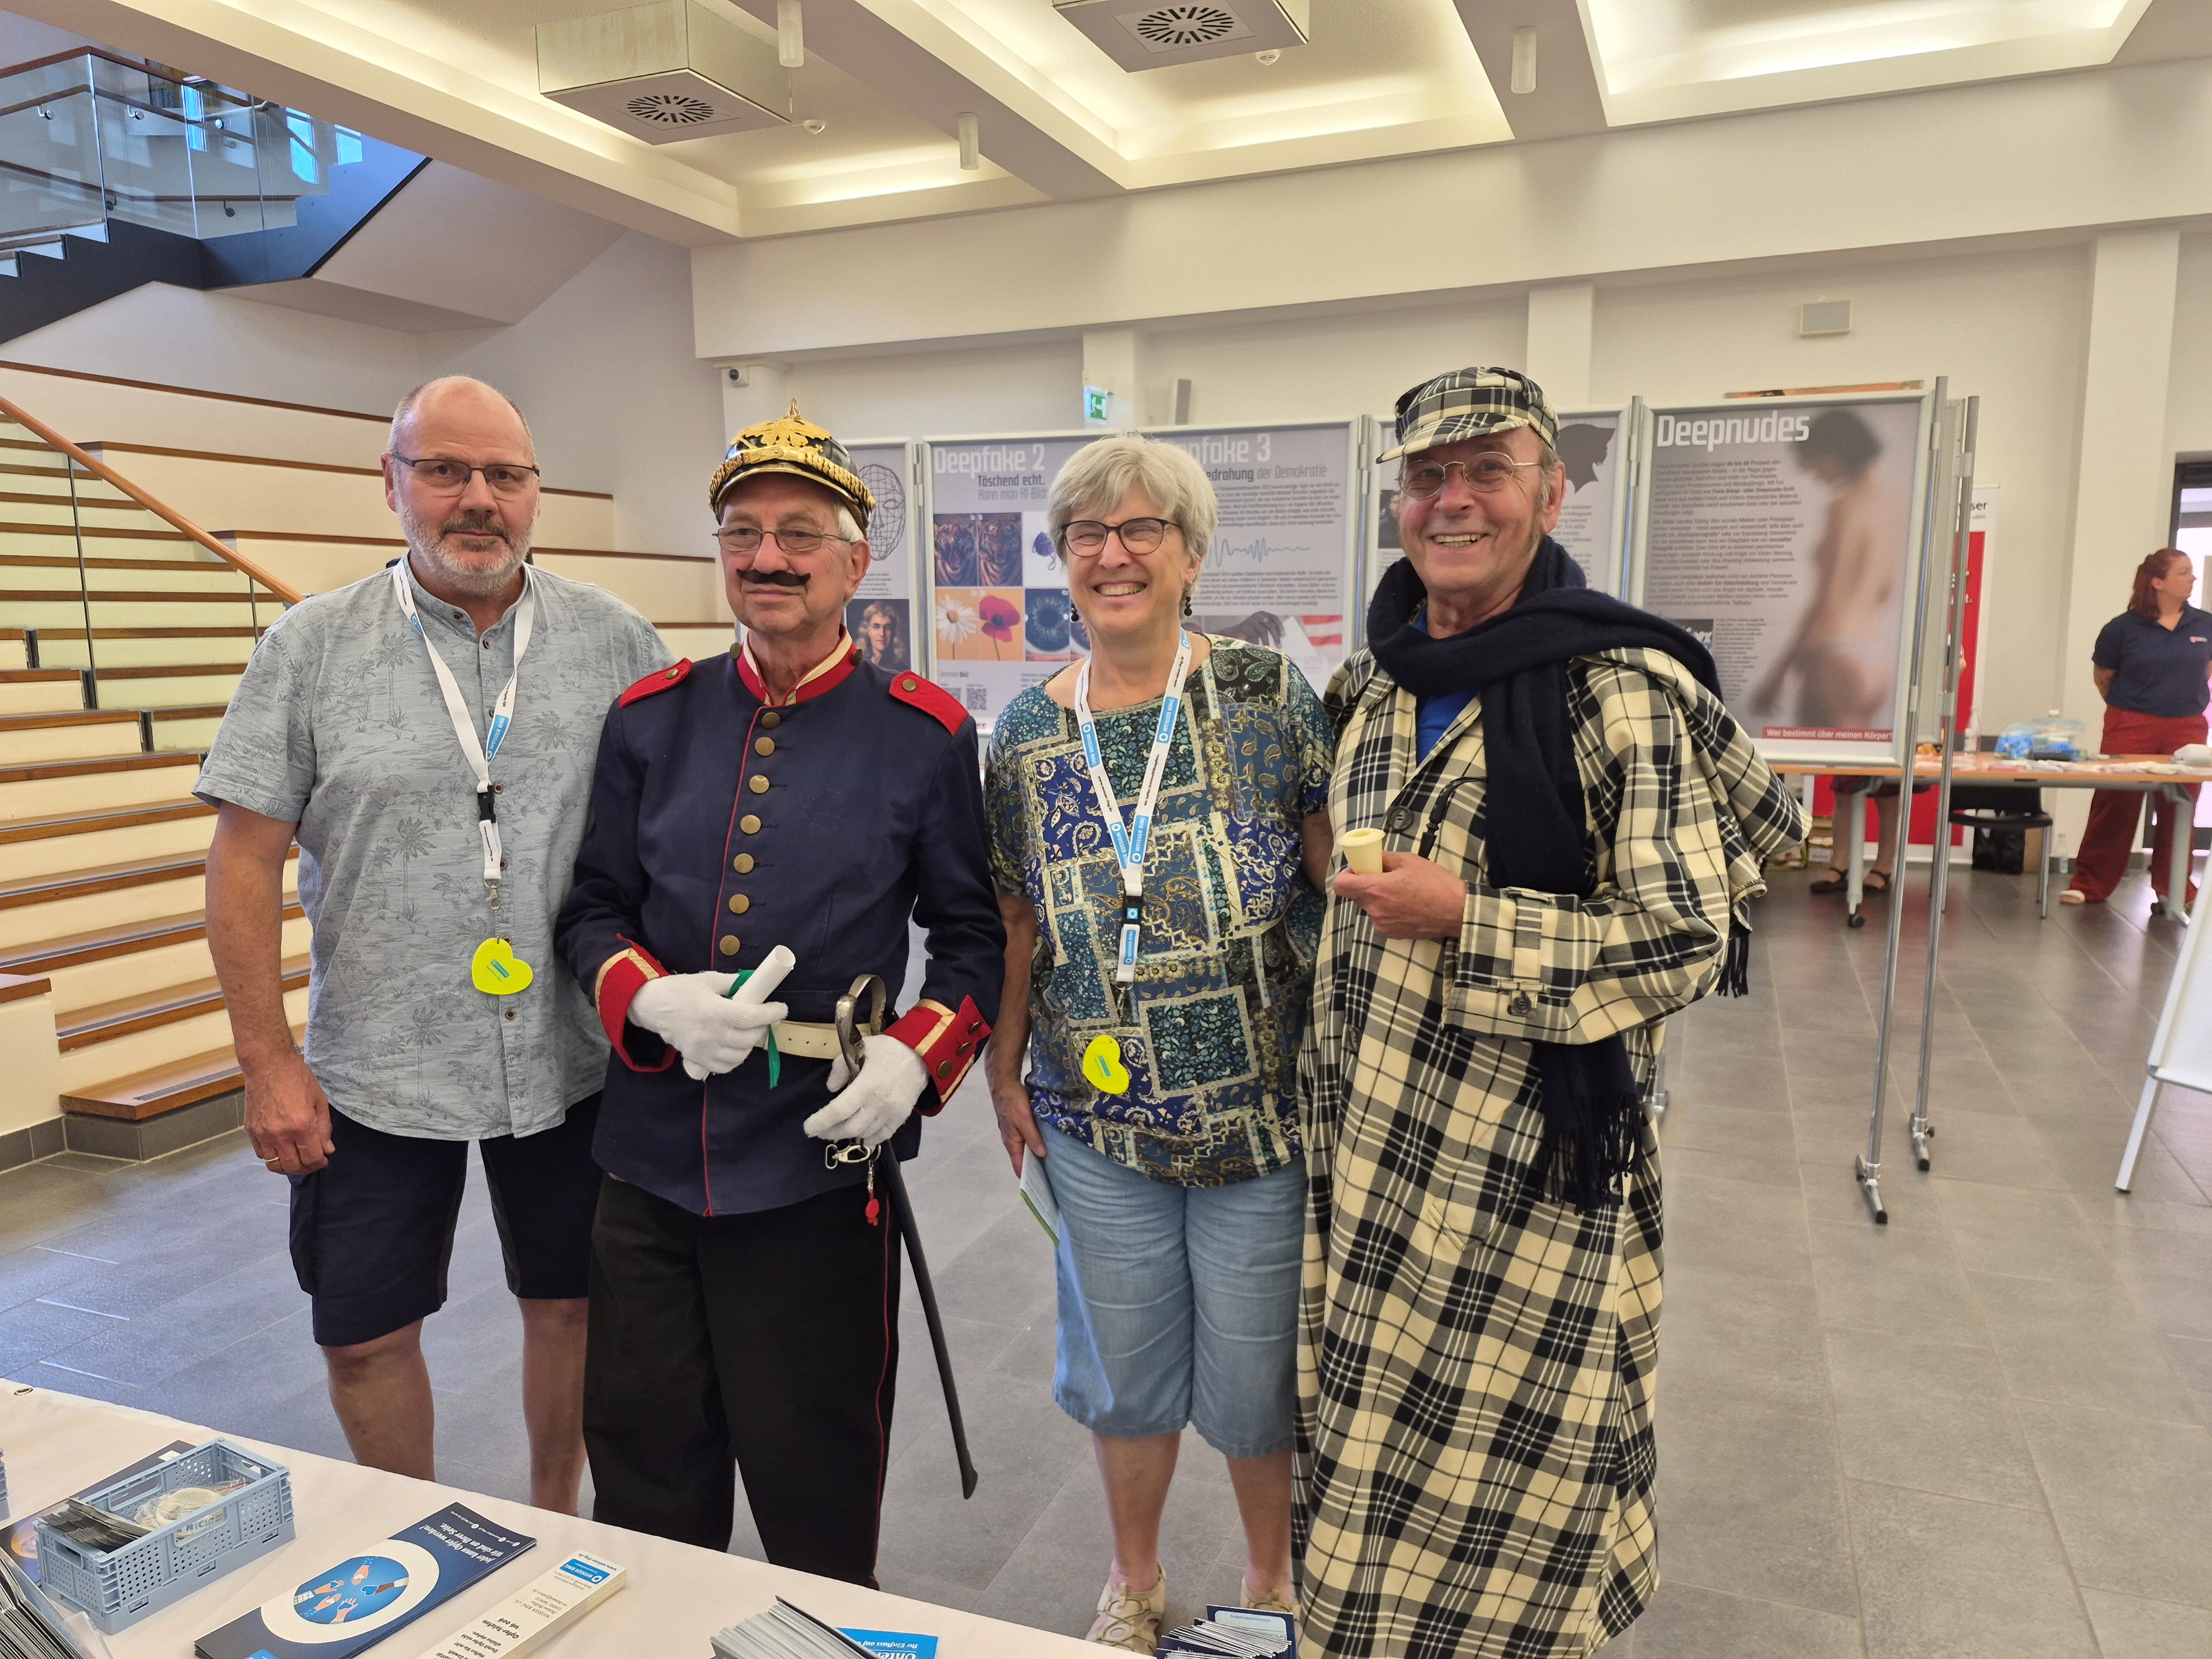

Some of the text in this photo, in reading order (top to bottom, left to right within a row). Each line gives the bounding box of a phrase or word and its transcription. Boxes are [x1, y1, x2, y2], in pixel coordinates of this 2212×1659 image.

[1657, 410, 1809, 452] Deepnudes
[1184, 433, 1270, 465] pfake 3
[933, 444, 1045, 479] Deepfake 2
[1022, 474, 1045, 486] echt.
[1206, 465, 1327, 482] edrohung der Demokratie
[978, 489, 998, 500] Kann
[1000, 491, 1018, 500] man
[1162, 713, 1171, 732] WEISSER
[490, 729, 502, 750] WEISSER
[1767, 728, 1781, 737] Wer
[1783, 729, 1816, 738] bestimmt
[1818, 729, 1834, 738] über
[1835, 731, 1863, 739] meinen
[1086, 733, 1094, 753] WEISSER
[1115, 832, 1126, 854] WEISSER
[441, 1522, 457, 1535] Seite.
[419, 1524, 496, 1564] Jeder kann Opfer werden!
[455, 1532, 473, 1543] Ihrer
[477, 1543, 493, 1553] sind
[574, 1568, 593, 1578] WEISSER
[531, 1608, 550, 1619] WEISSER
[482, 1619, 520, 1639] Opfer-Telefon
[472, 1631, 502, 1646] alleine stehen.
[472, 1639, 486, 1647] Opfer
[447, 1649, 465, 1659] Gewalt.
[470, 1649, 486, 1658] Helfen
[483, 1644, 498, 1653] Damit
